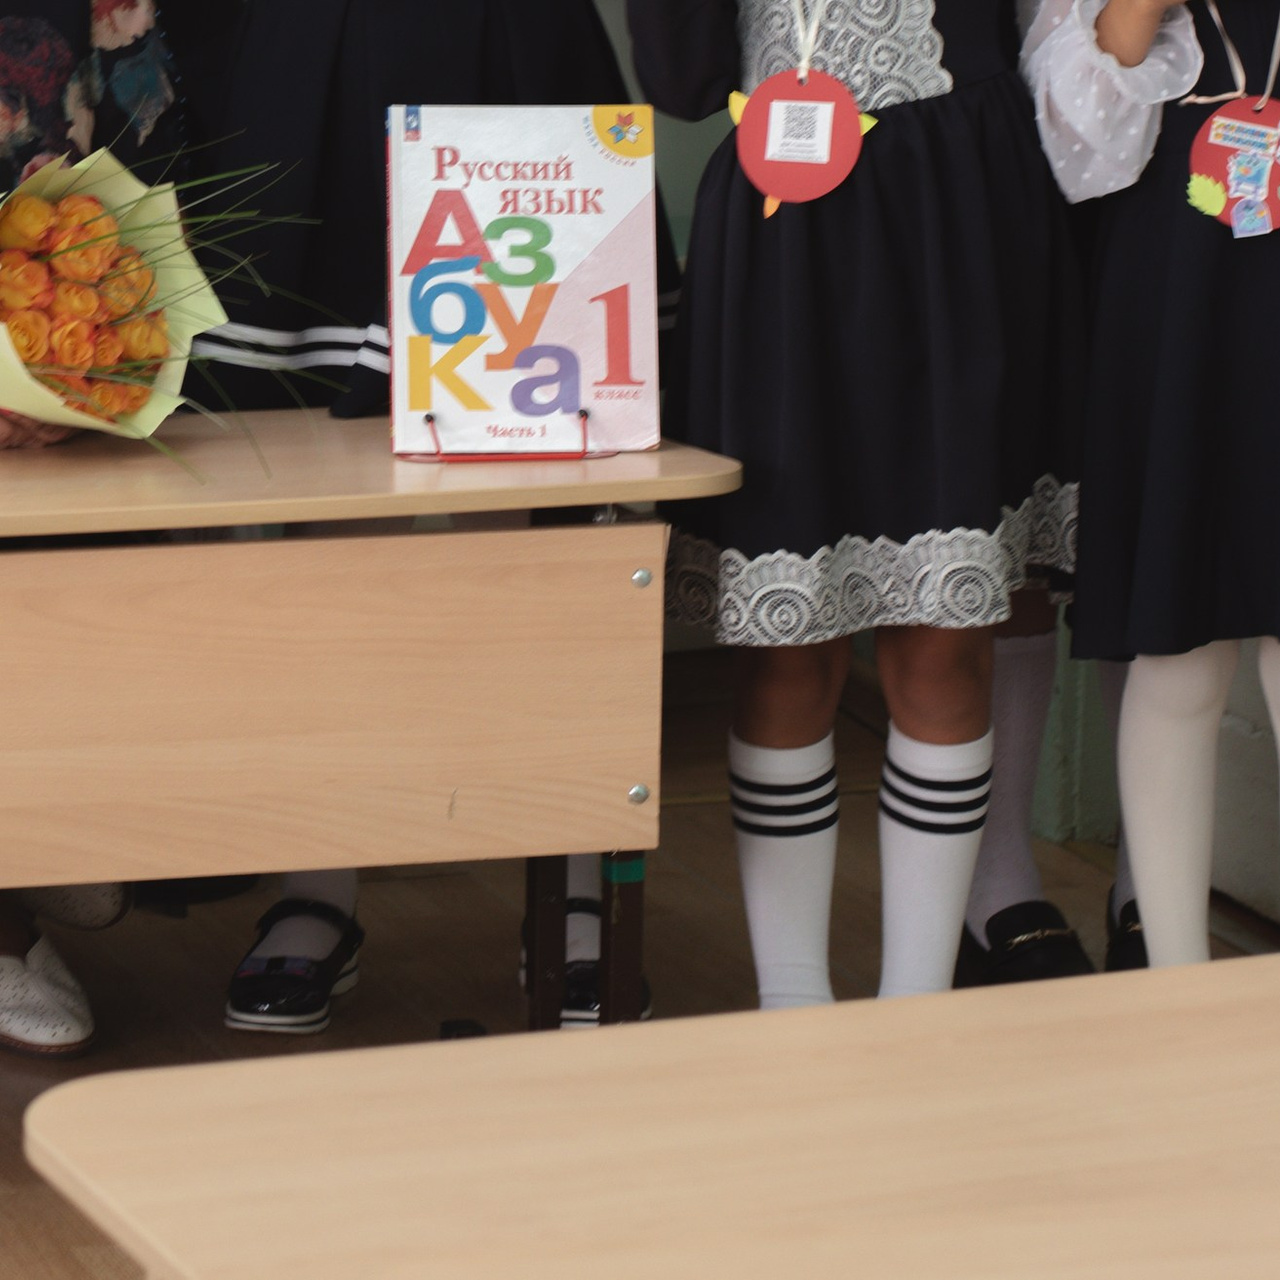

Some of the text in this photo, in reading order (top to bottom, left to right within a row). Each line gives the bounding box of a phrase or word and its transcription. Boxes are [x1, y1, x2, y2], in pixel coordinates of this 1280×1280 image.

[431, 146, 574, 188] Русский
[588, 282, 646, 387] 1
[485, 423, 548, 438] Часть 1
